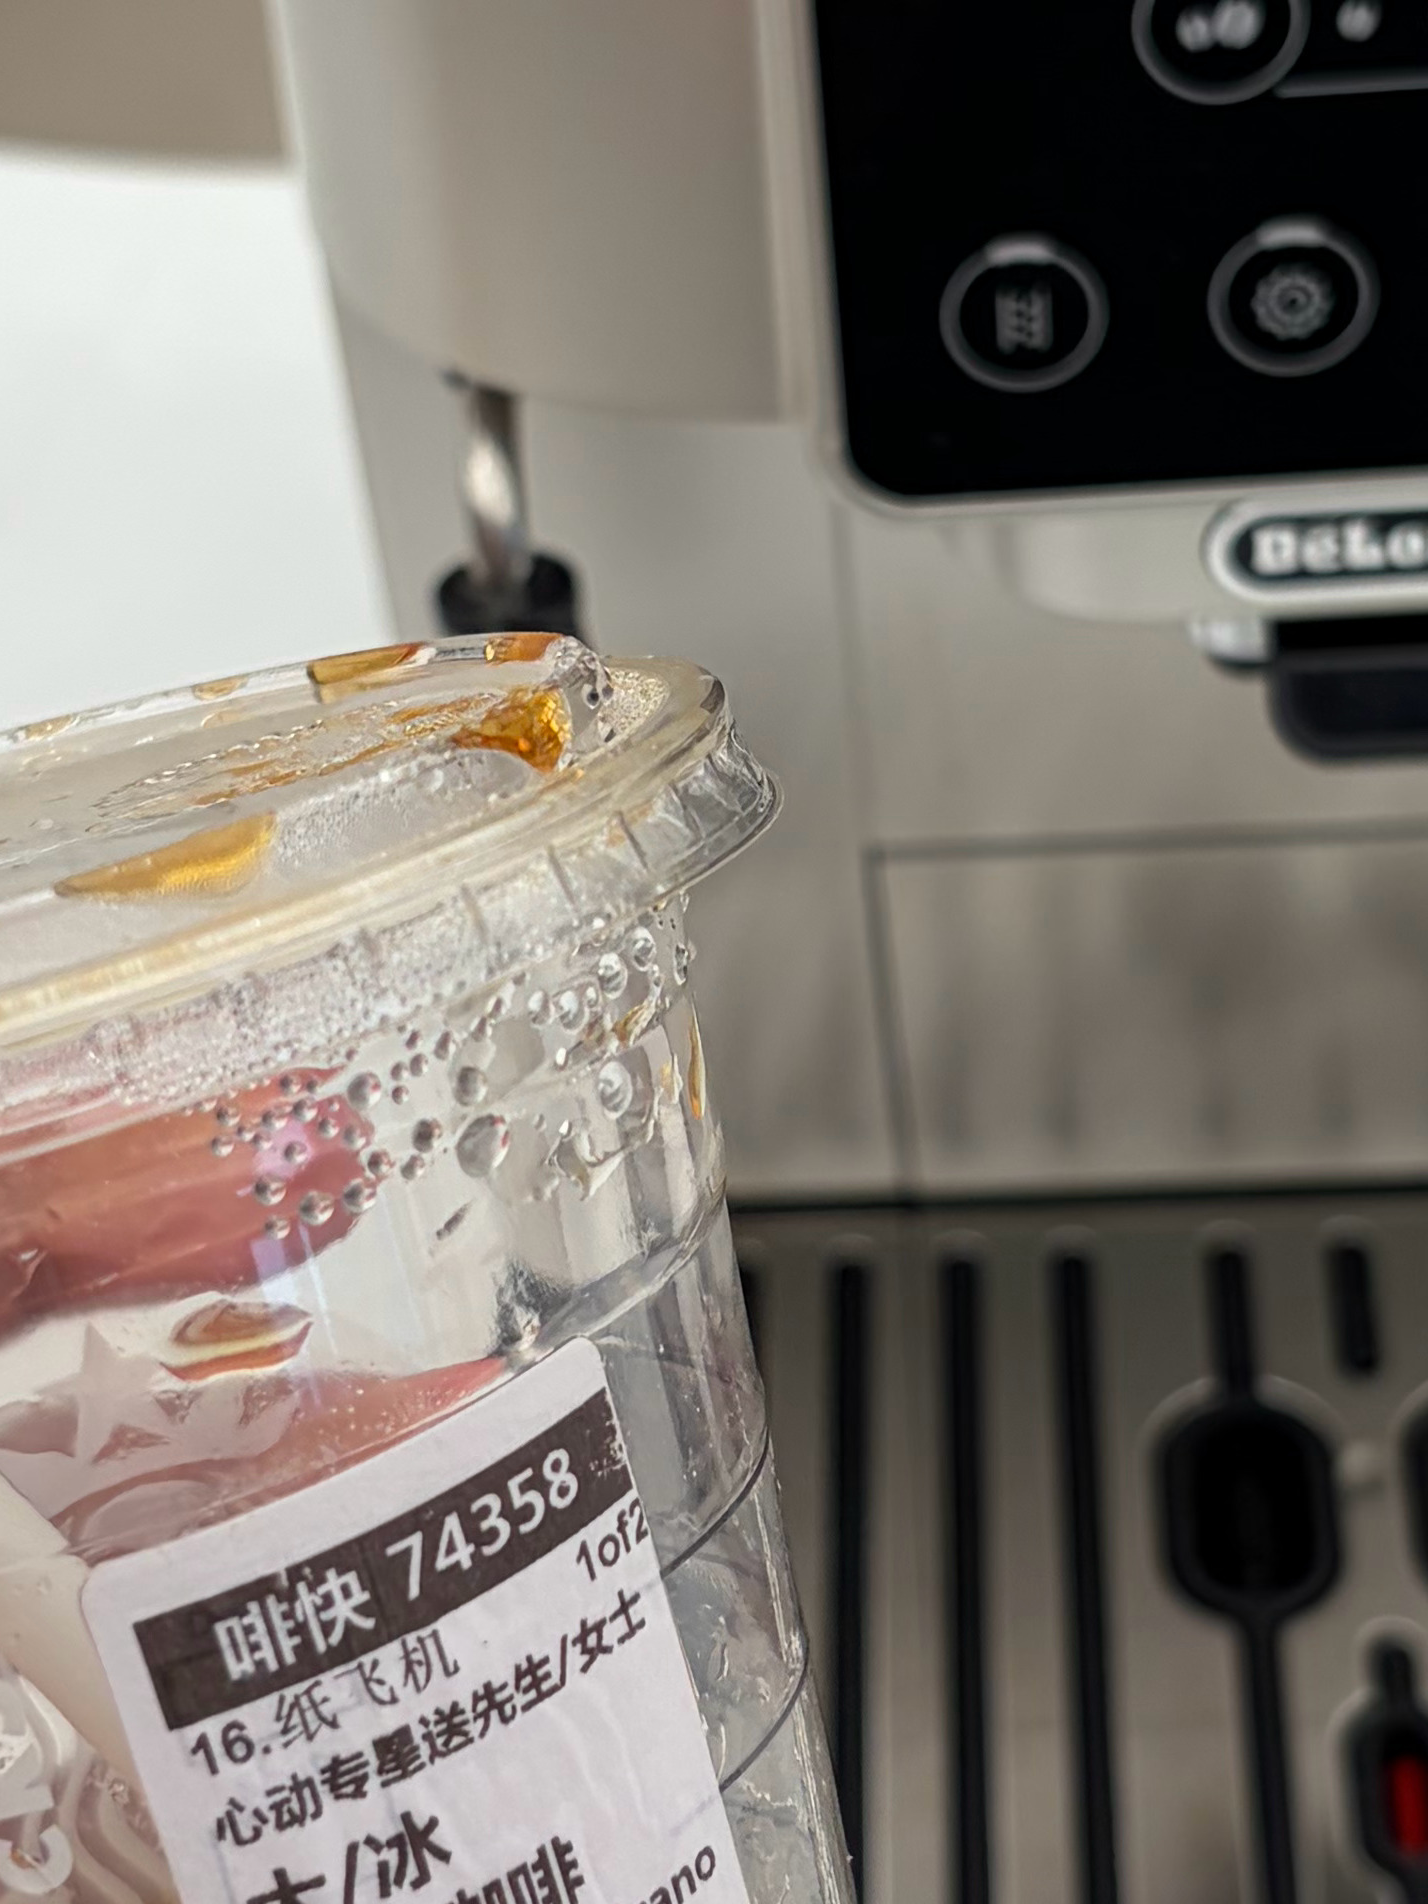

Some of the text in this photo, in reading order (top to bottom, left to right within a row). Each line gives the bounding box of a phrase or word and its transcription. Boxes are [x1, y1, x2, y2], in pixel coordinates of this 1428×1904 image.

[213, 1449, 578, 1681] 啡快 74358
[576, 1498, 649, 1581] 1of2
[191, 1629, 460, 1775] 16.纸飞机
[214, 1589, 647, 1846] 心动专星送先生/女士
